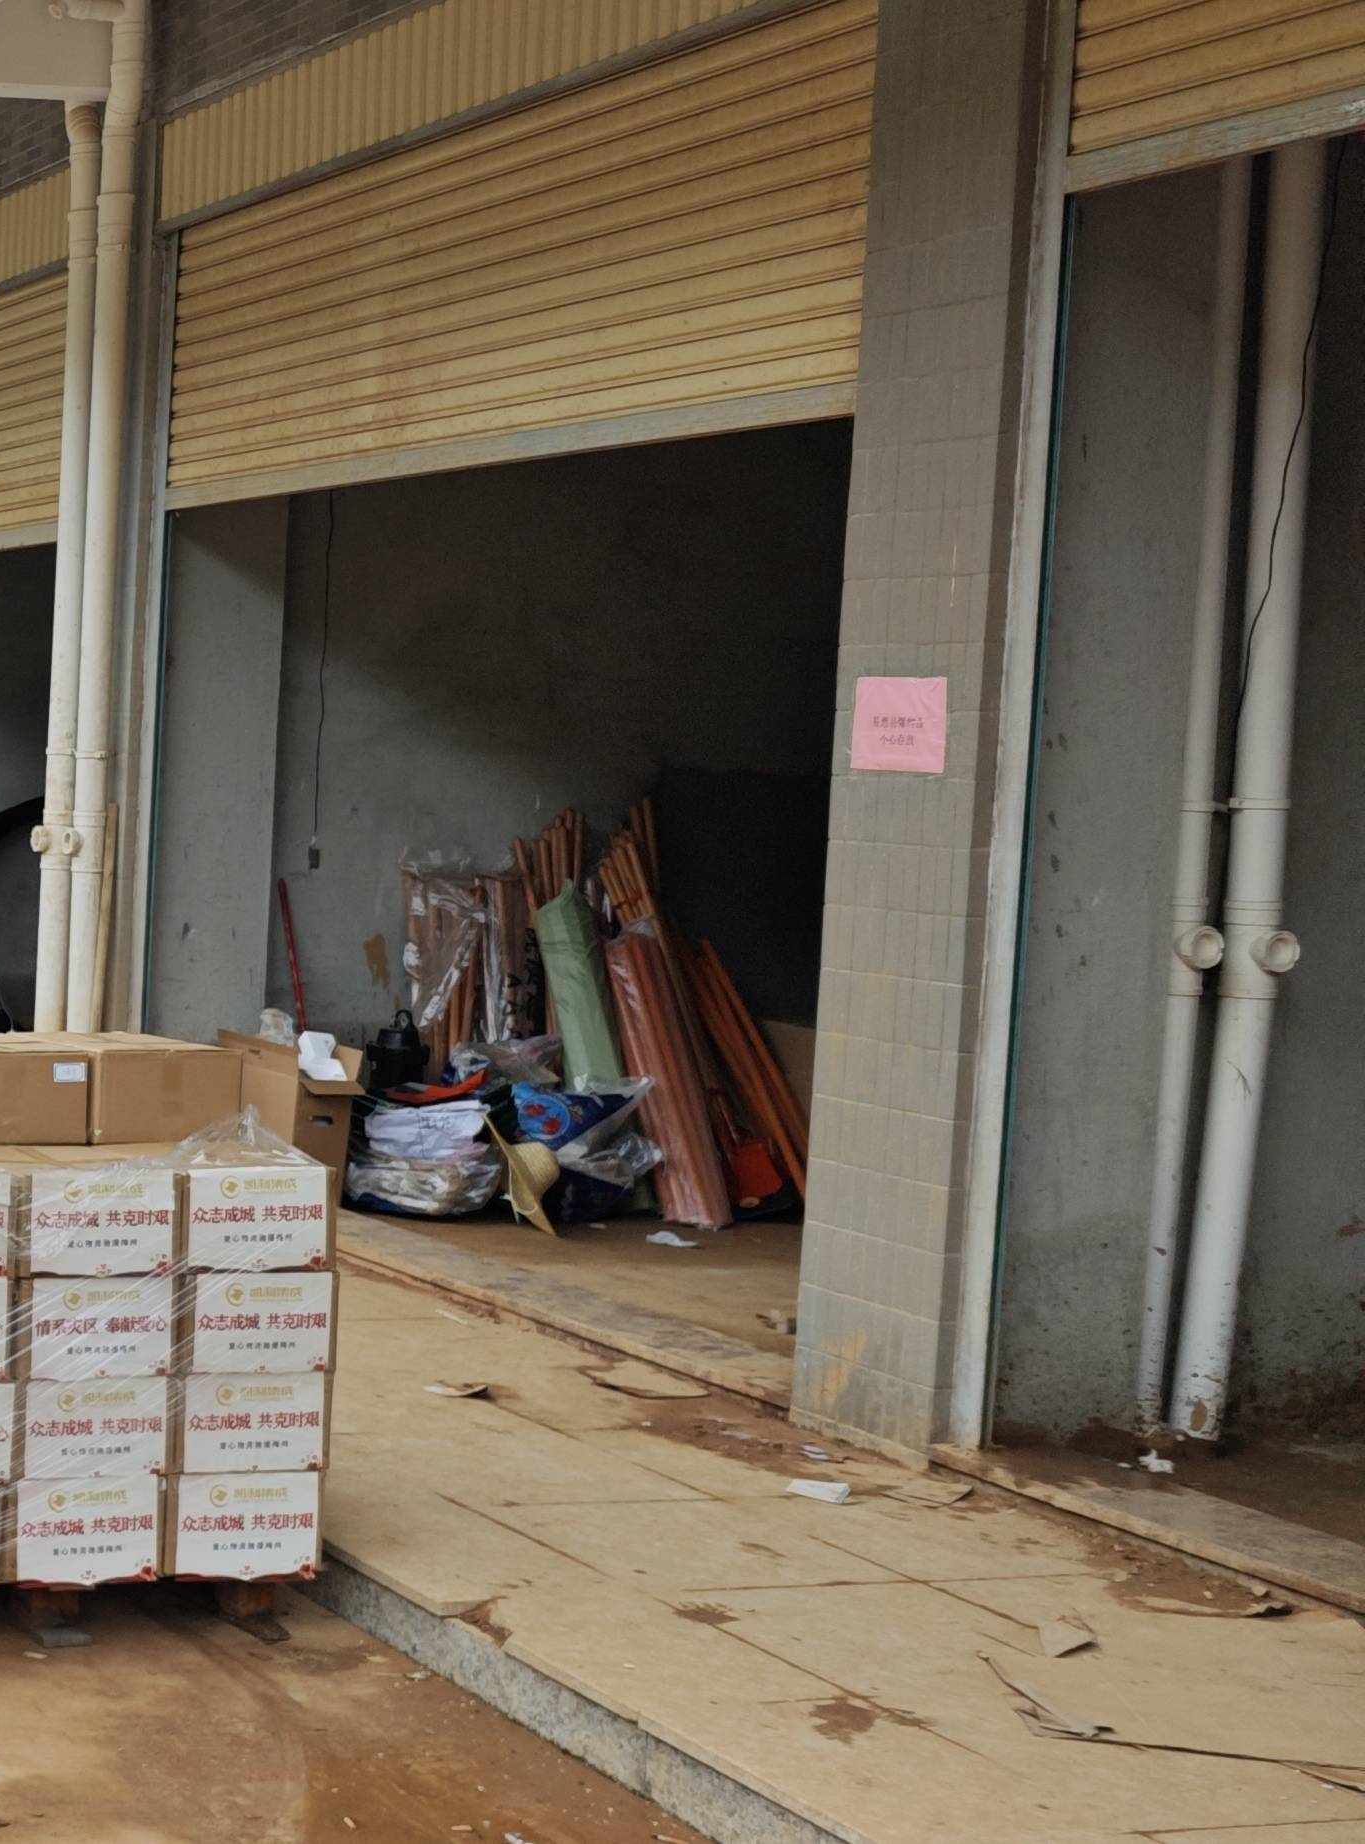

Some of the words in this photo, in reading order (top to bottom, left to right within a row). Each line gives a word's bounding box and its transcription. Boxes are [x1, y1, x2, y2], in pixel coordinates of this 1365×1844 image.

[35, 1210, 100, 1230] 众志成城
[105, 1209, 170, 1228] 共克时艰
[192, 1206, 256, 1224] 众志成城
[261, 1204, 323, 1222] 共克时艰
[197, 1313, 261, 1331] 众志成城
[266, 1311, 327, 1329] 共克时艰
[188, 1413, 252, 1432] 众志成城
[257, 1410, 320, 1430] 共克时艰
[20, 1519, 85, 1538] 众志成城
[91, 1514, 154, 1534] 共克时艰
[181, 1513, 245, 1532] 众志成城
[251, 1512, 314, 1530] 共克时艰
